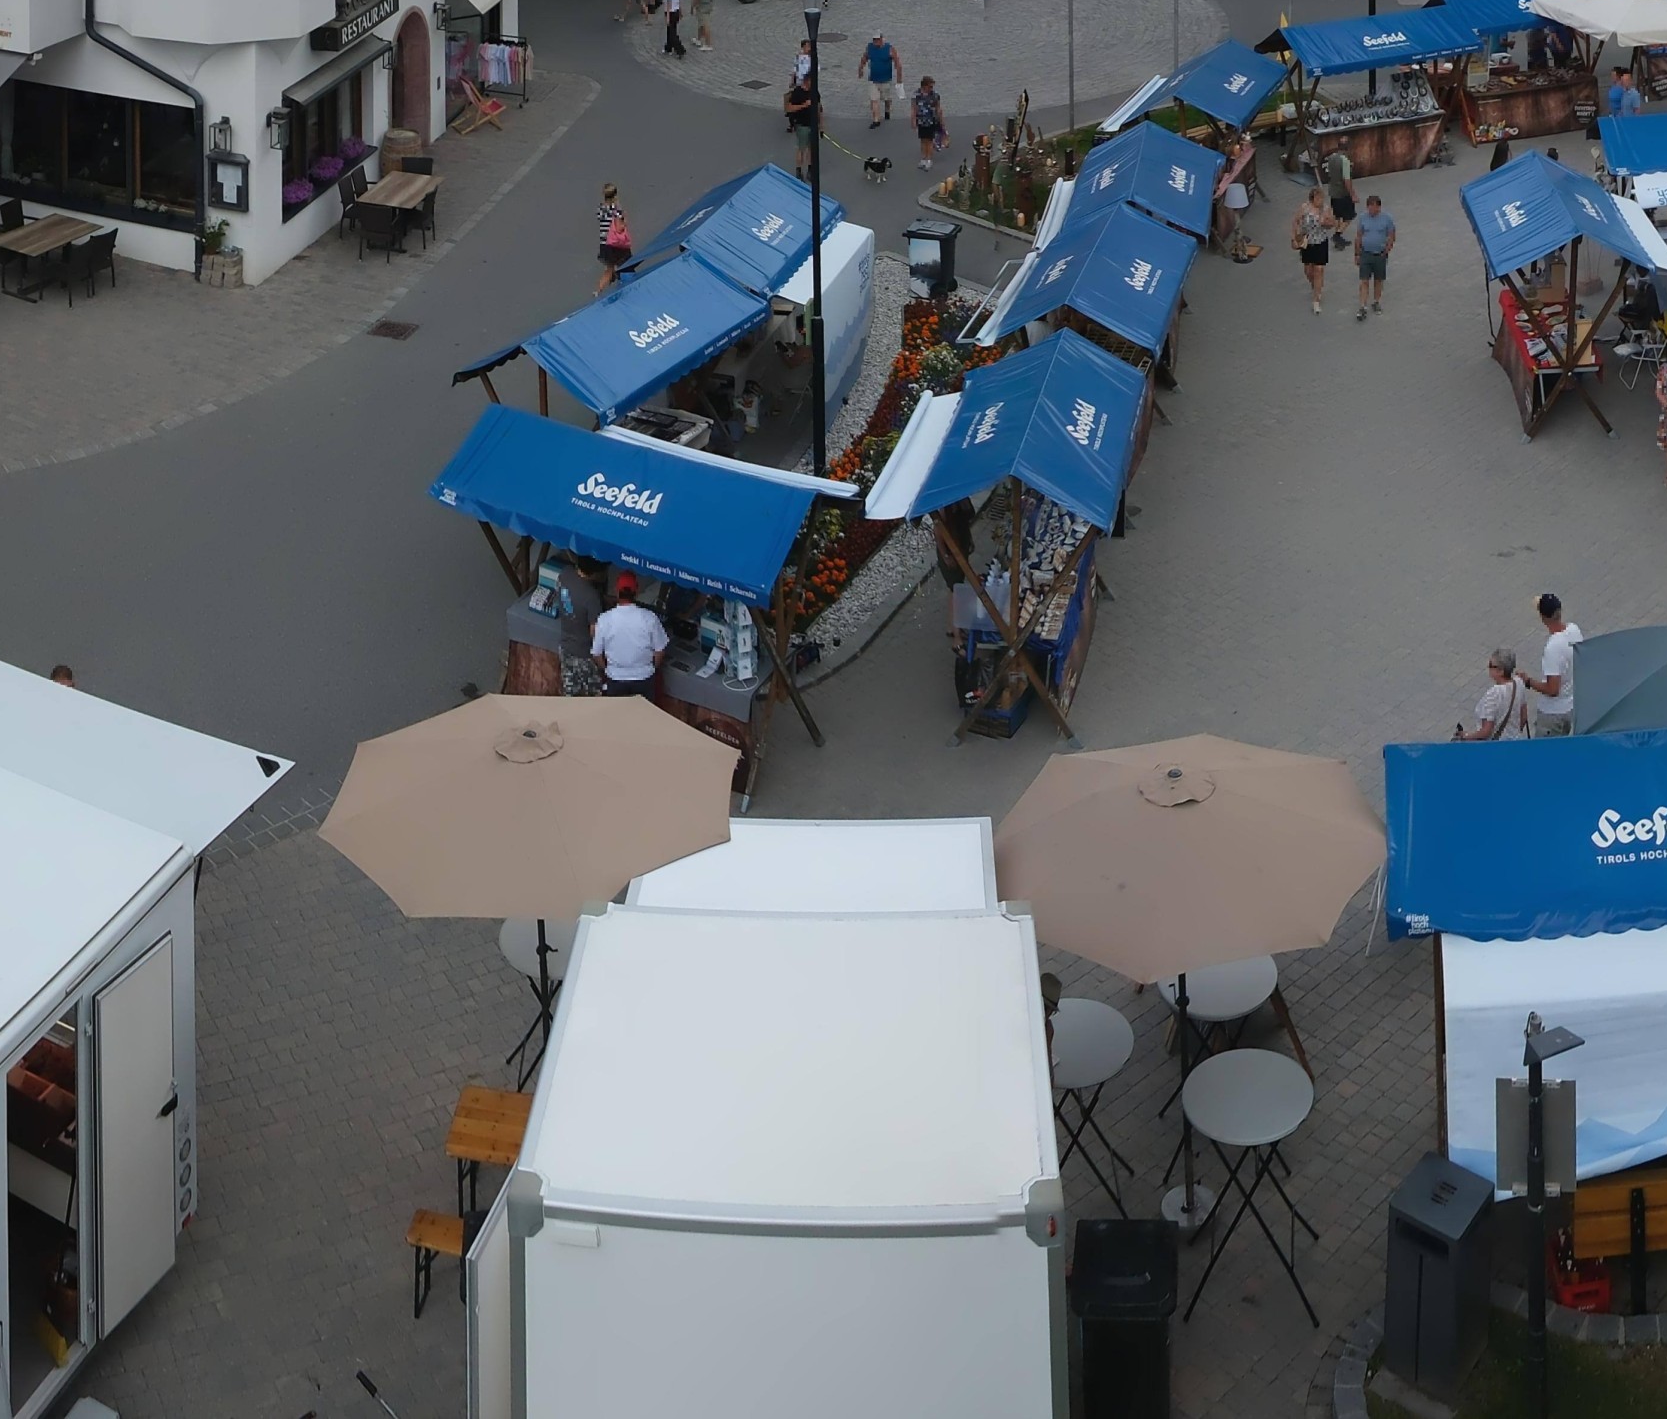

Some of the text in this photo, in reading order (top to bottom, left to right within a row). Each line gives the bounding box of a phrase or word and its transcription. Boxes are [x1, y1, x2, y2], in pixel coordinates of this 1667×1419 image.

[1363, 32, 1407, 48] Seefeld
[628, 312, 680, 348] Seefeld
[1066, 398, 1097, 446] Seefeld
[577, 472, 663, 515] Seefeld
[571, 497, 649, 527] TIROLS HOCHPLATEAU
[1596, 851, 1636, 865] TIROLS
